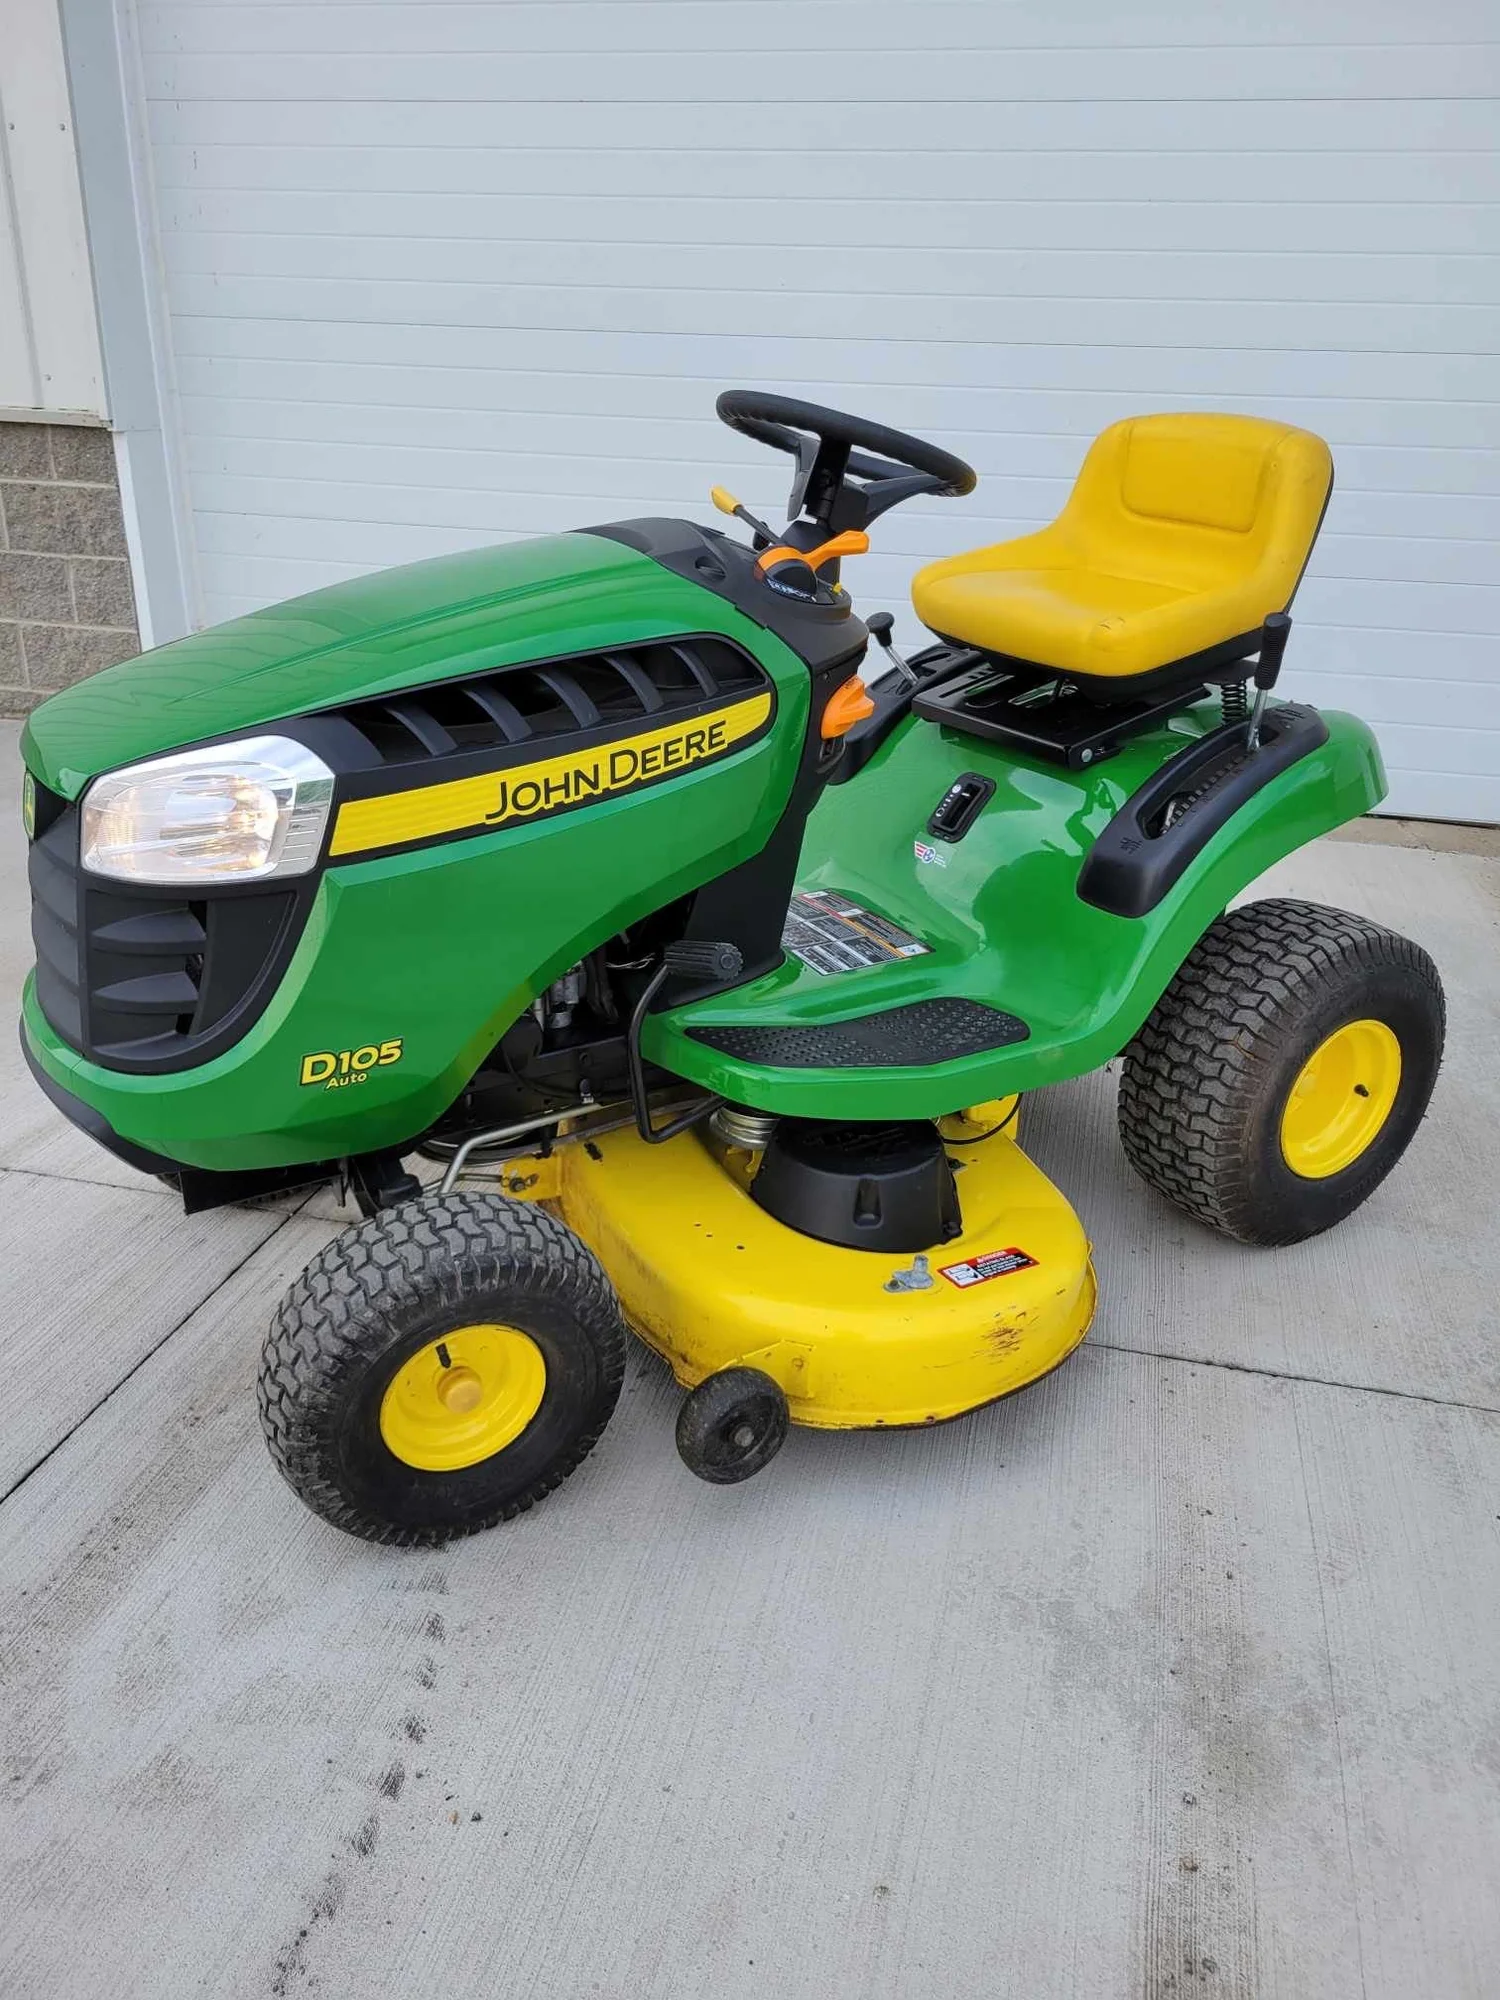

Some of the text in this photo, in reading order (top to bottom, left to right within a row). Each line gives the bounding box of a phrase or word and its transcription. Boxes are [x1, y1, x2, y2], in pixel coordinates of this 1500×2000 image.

[485, 719, 727, 820] JOHN DEERE
[300, 1038, 403, 1086] D105
[325, 1071, 368, 1090] Auto
